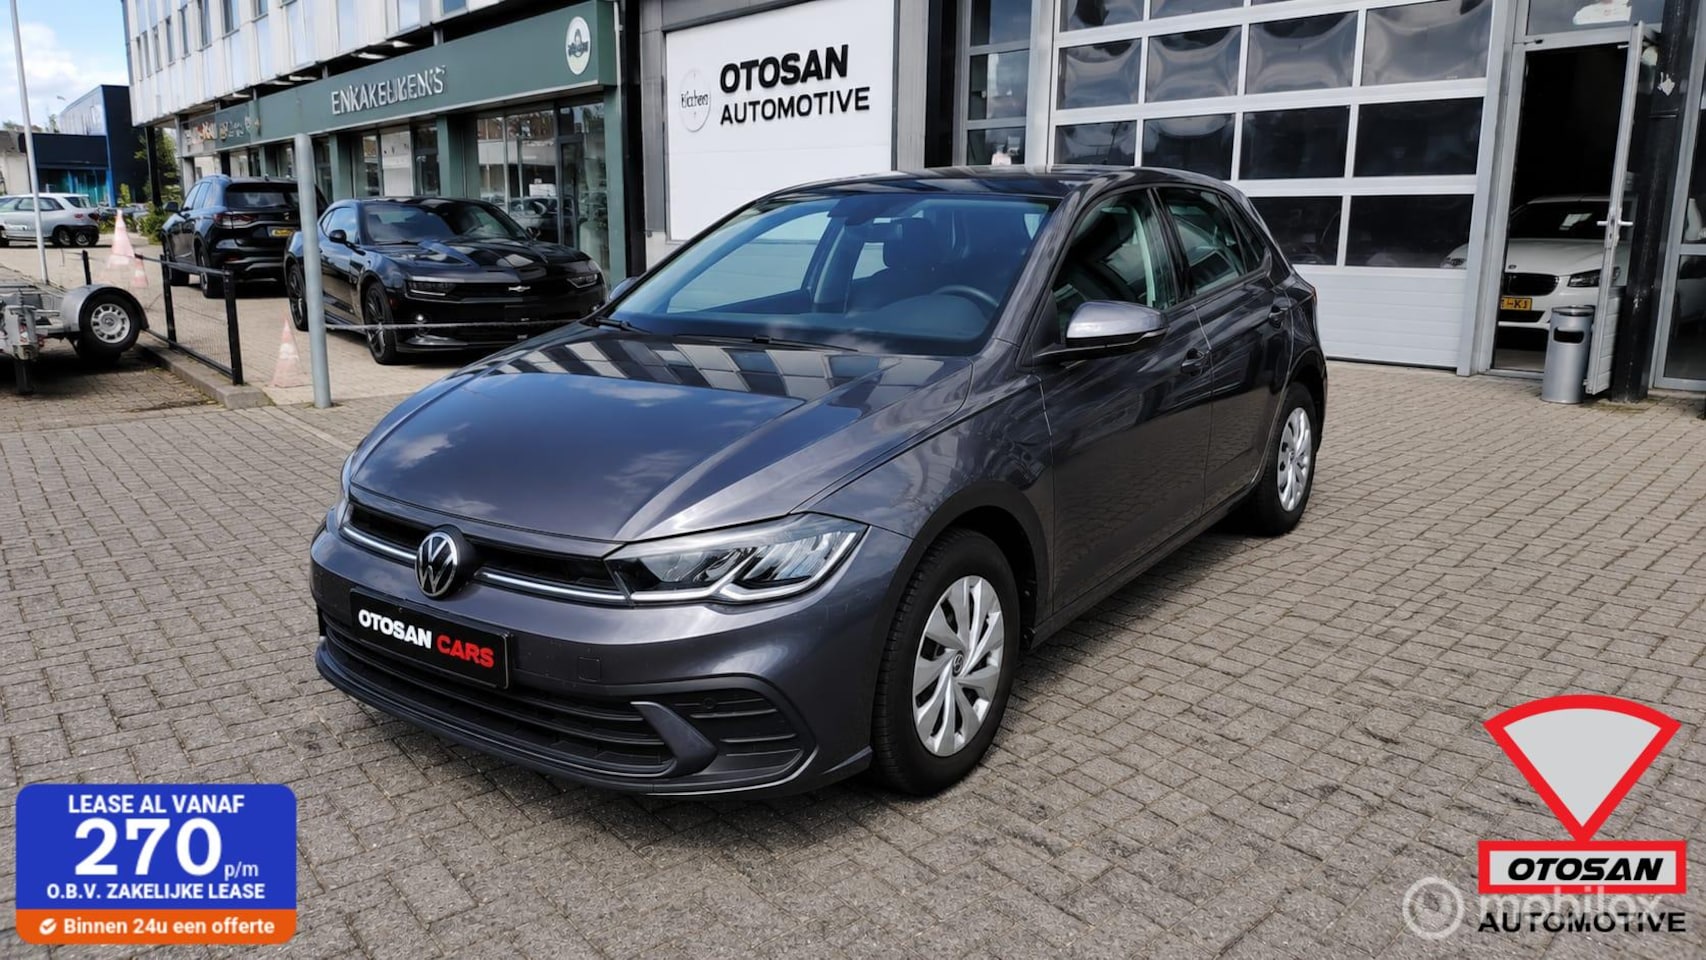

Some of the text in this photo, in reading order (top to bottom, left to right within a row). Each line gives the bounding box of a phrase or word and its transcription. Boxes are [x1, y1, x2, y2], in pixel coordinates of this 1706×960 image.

[720, 44, 849, 94] OTOSAN
[720, 86, 870, 125] AUTOMOTIVE
[358, 609, 494, 668] OTOSAN CARS
